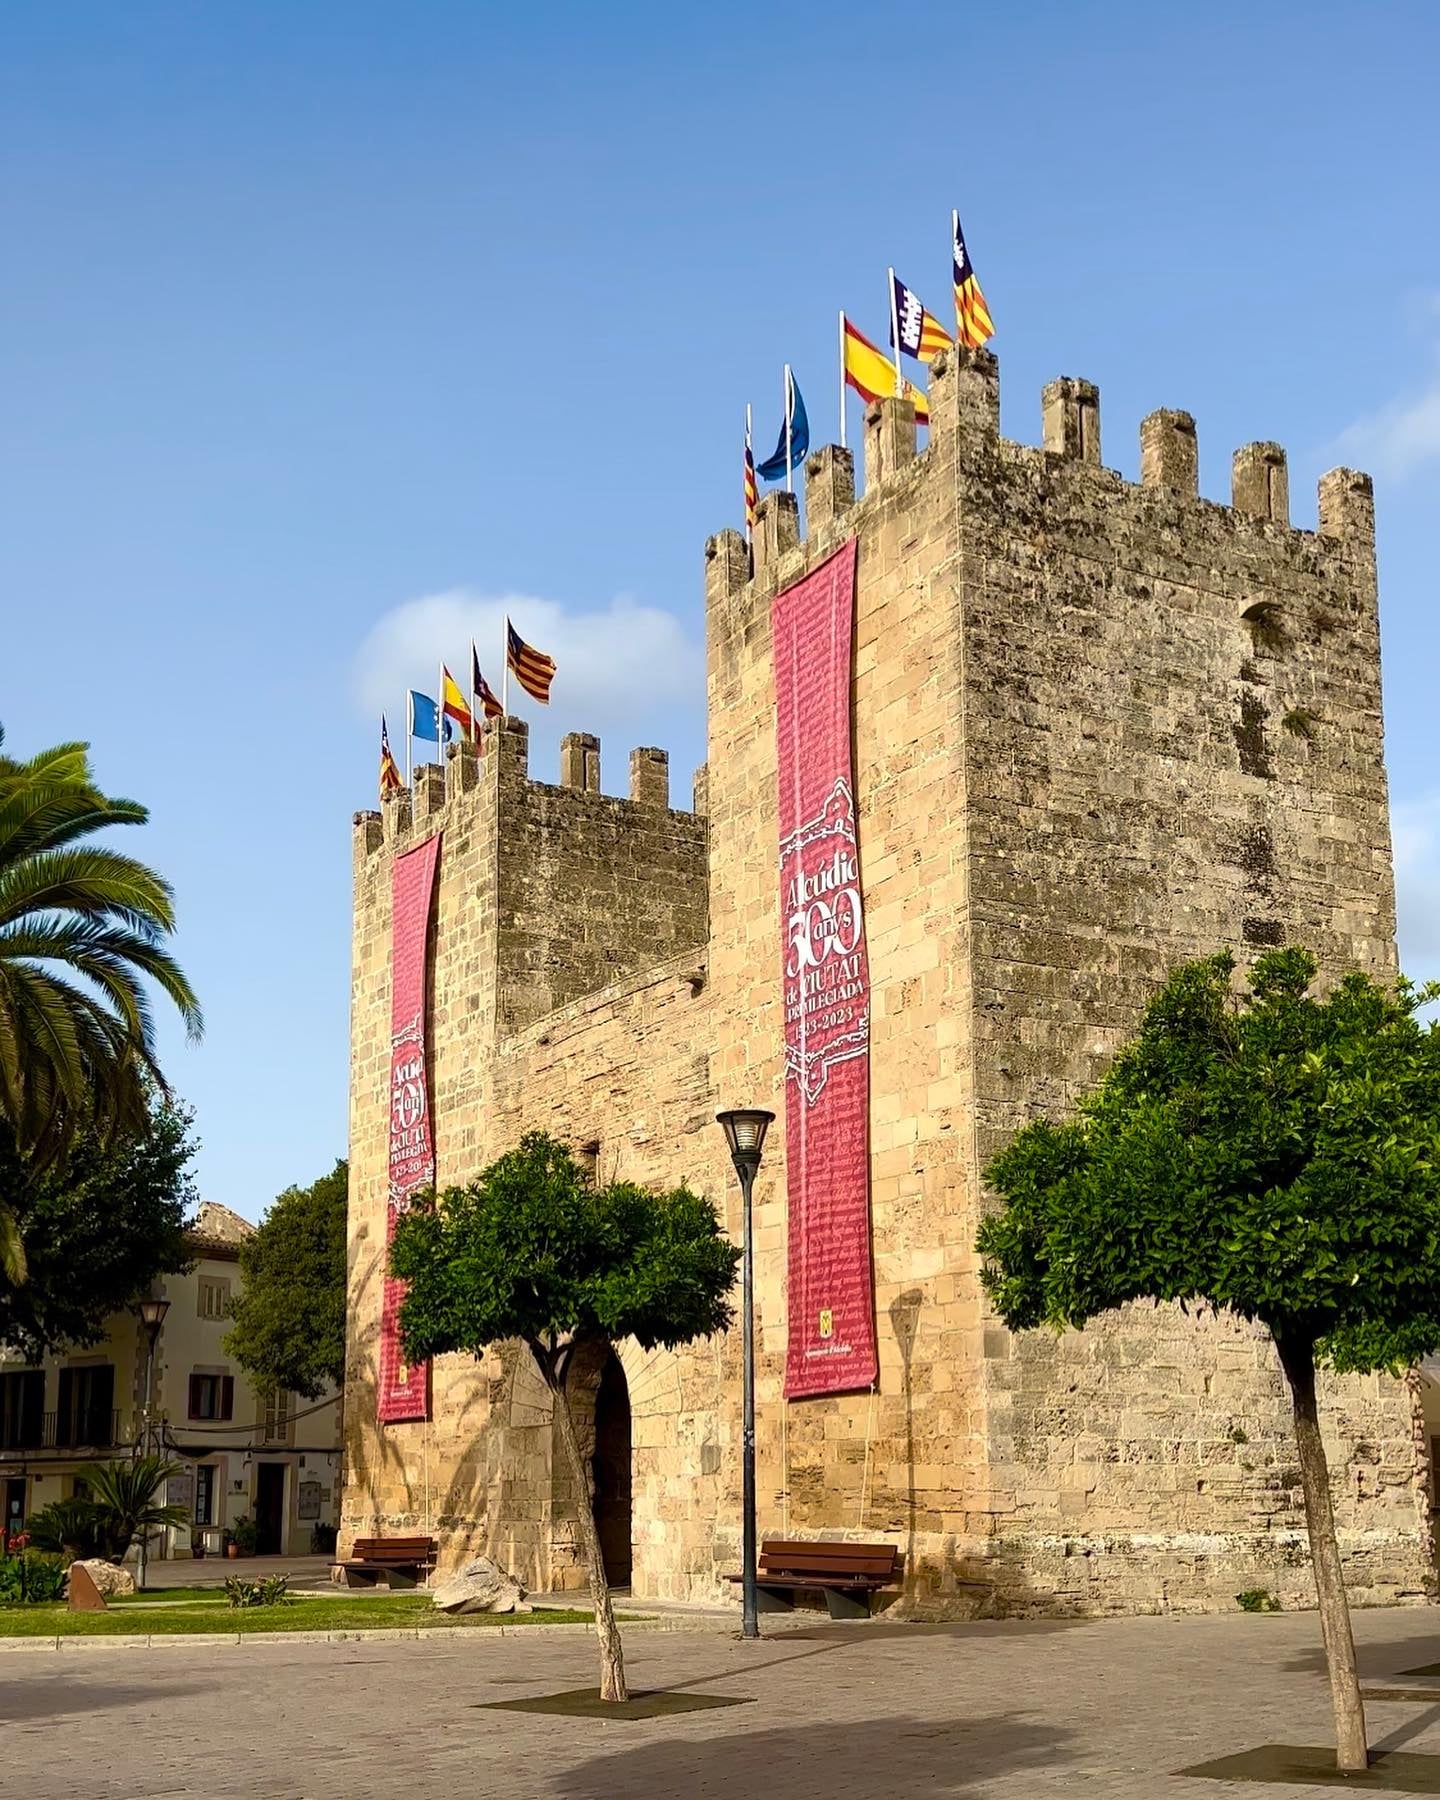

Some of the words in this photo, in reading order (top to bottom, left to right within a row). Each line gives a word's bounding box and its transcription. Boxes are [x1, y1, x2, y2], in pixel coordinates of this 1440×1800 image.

[787, 887, 862, 978] 500
[814, 910, 851, 941] anys
[800, 953, 863, 998] CIUTAT
